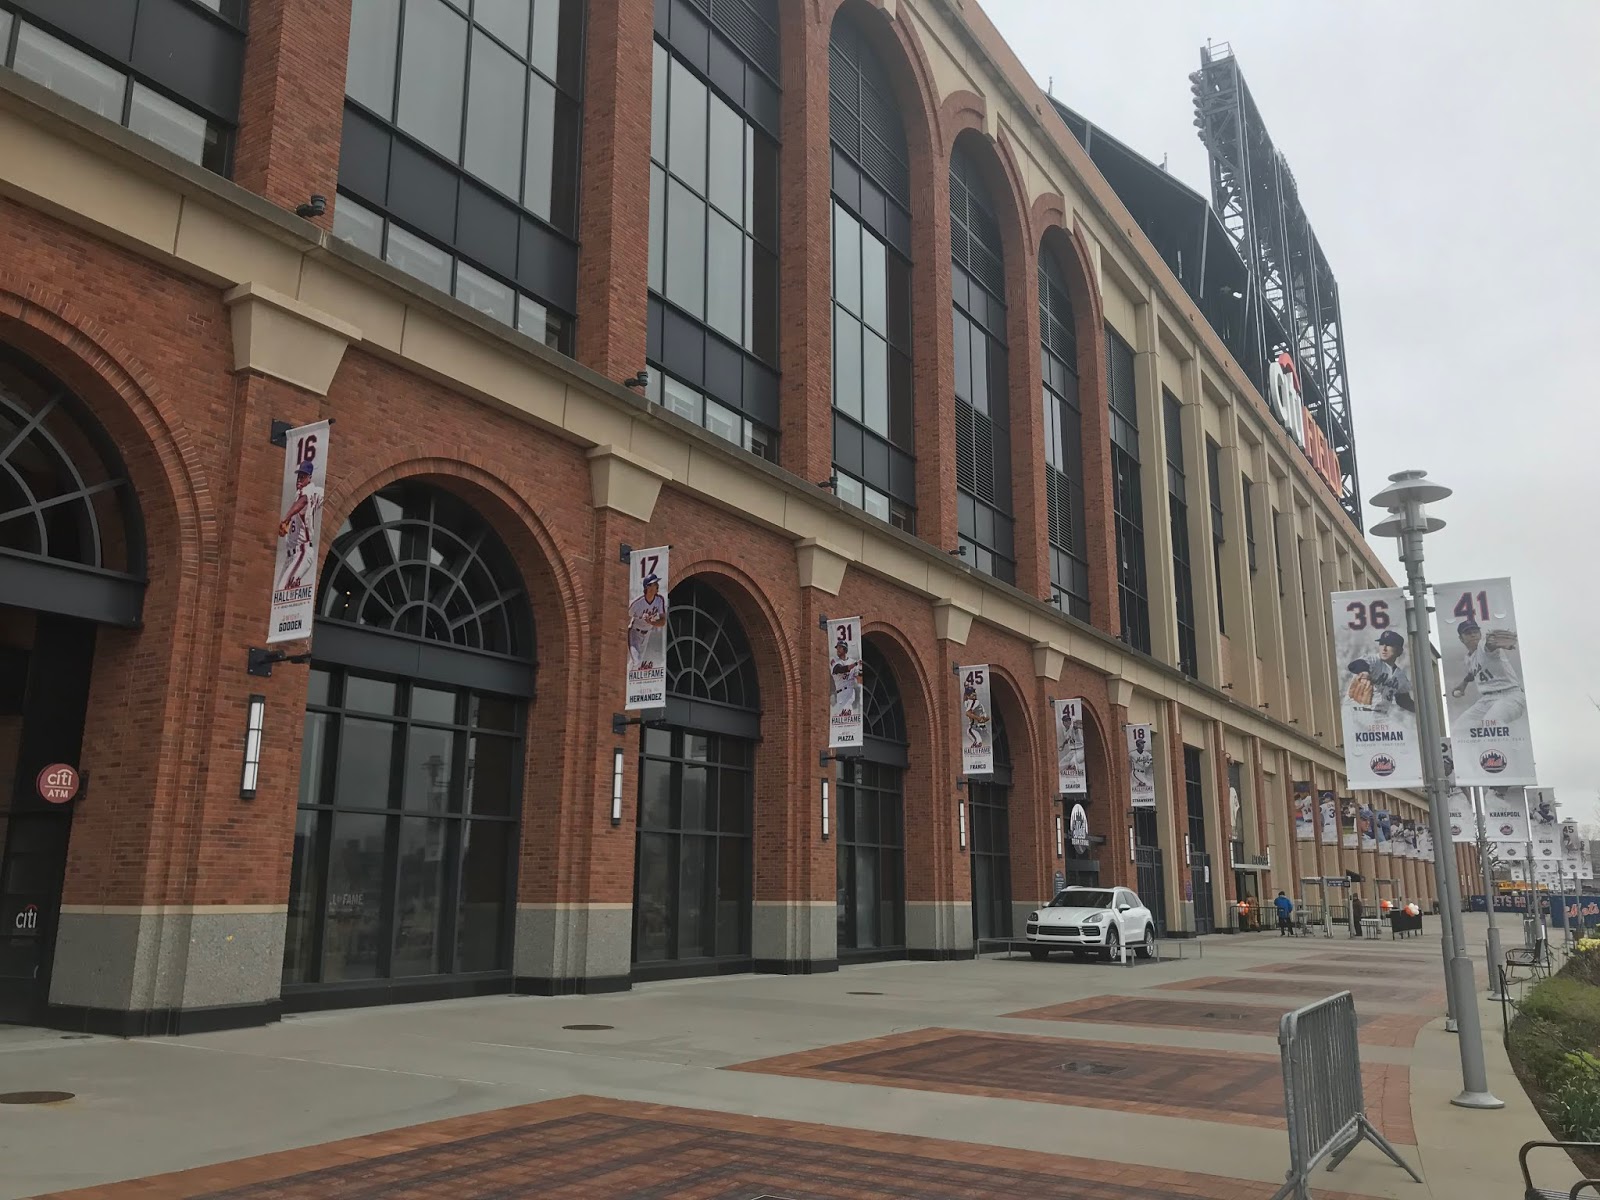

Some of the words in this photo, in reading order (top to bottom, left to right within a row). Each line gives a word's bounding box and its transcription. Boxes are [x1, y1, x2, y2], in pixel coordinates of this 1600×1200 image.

[297, 434, 317, 465] 16
[640, 555, 658, 578] 17
[274, 590, 289, 603] HALL
[295, 587, 312, 599] FAME
[1453, 591, 1490, 621] 41
[1346, 600, 1390, 630] 36
[279, 620, 302, 632] GOODEN
[836, 624, 852, 641] 31
[629, 671, 643, 680] HALL
[648, 668, 664, 678] FAME
[966, 670, 984, 685] 45
[630, 693, 662, 703] HERNANDEZ
[1062, 703, 1076, 717] 41
[832, 716, 843, 725] HALL
[847, 715, 861, 724] FAME
[1132, 728, 1145, 740] 18
[1355, 731, 1404, 742] KOOSMAN
[1470, 727, 1510, 737] SEAVER
[47, 769, 72, 786] citi
[47, 789, 69, 798] ATM
[1563, 826, 1574, 834] 45
[16, 906, 37, 929] citi
